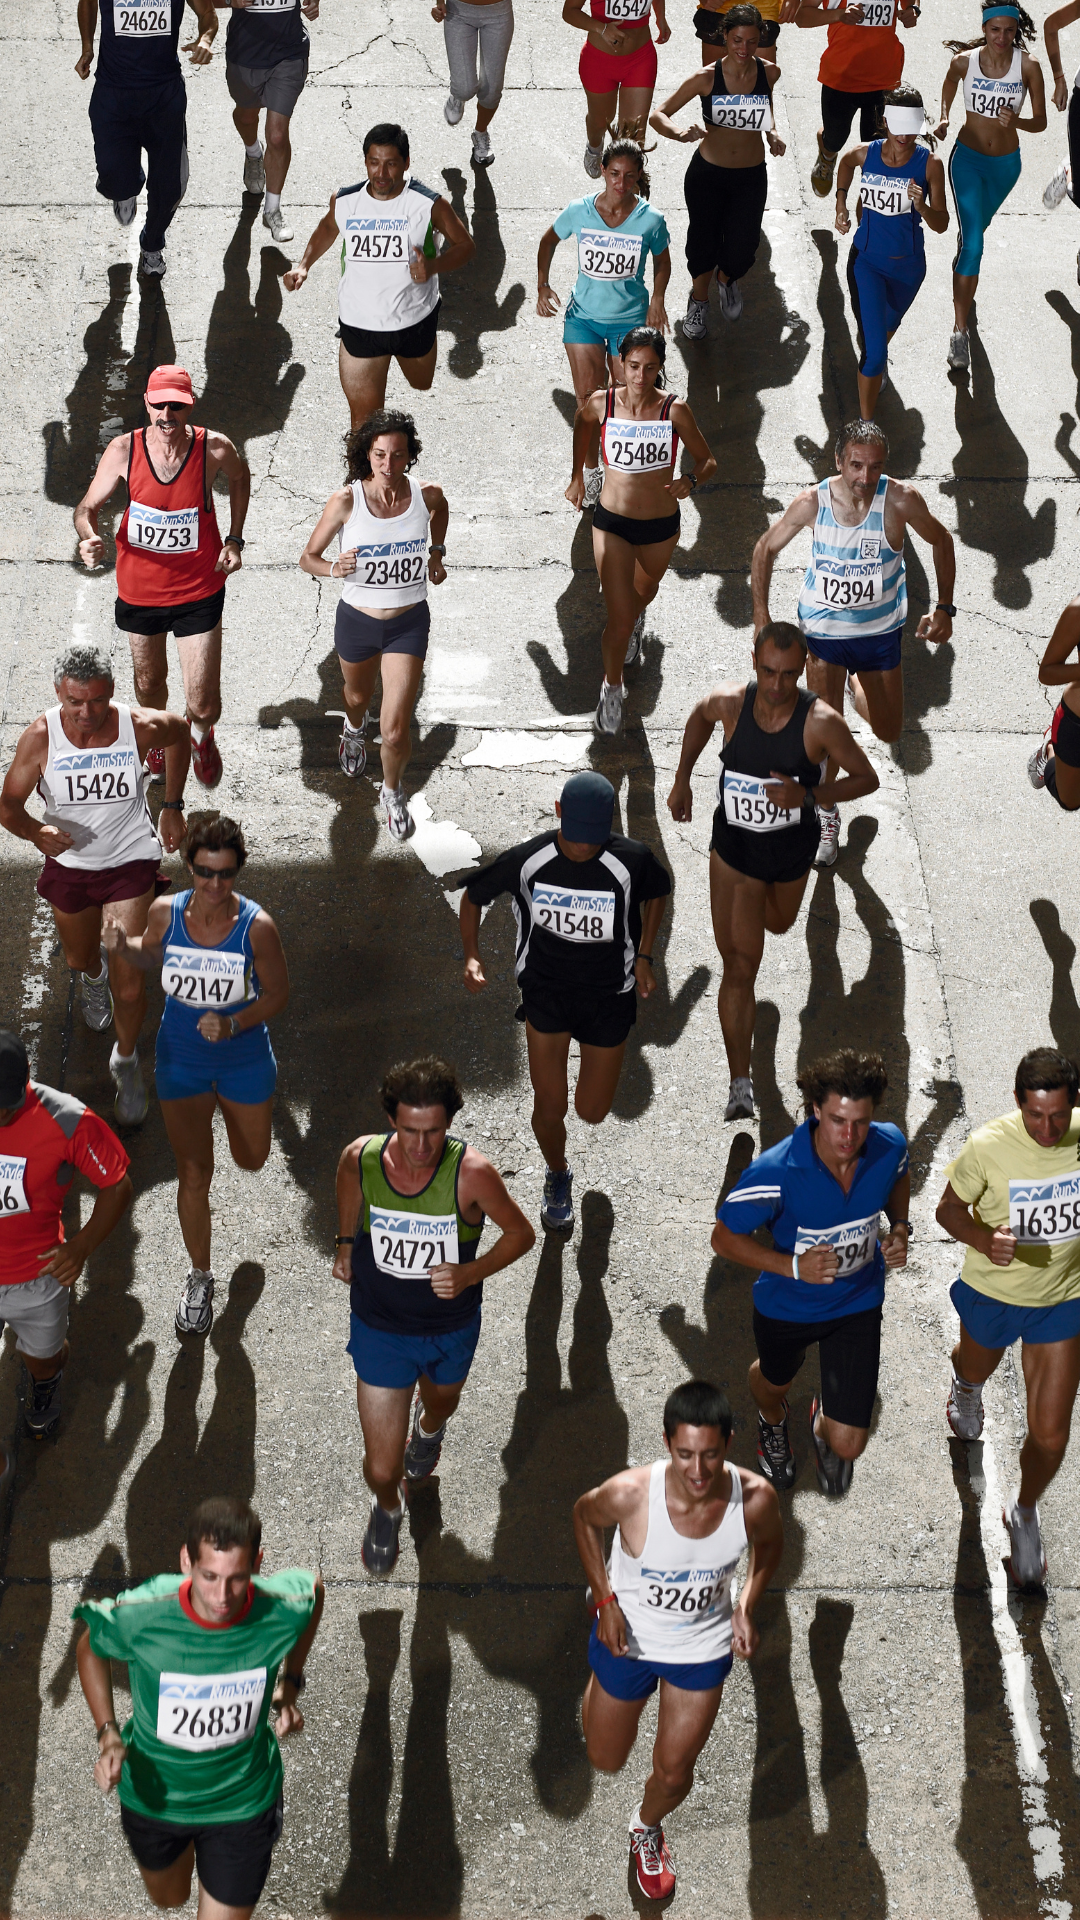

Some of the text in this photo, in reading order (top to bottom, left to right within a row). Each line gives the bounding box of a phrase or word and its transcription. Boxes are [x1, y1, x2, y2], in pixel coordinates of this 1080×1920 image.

[606, 0, 648, 17] 16542
[856, 4, 892, 26] 493
[120, 10, 167, 31] 24626
[993, 80, 1023, 94] RunStyle
[739, 94, 770, 106] RunStyle
[971, 92, 1016, 117] 13485
[717, 108, 766, 129] 23547
[880, 176, 911, 190] RunStyl
[860, 187, 902, 213] 21541
[374, 219, 408, 232] RunStyle
[351, 234, 403, 258] 24573
[607, 236, 642, 252] RunStyle
[584, 249, 636, 275] 32584
[635, 425, 672, 439] RunStyle
[611, 440, 669, 466] 25486
[161, 512, 199, 526] RunStyle
[136, 523, 191, 548] 19753
[389, 540, 426, 556] RunStyle
[365, 556, 423, 585] 23482
[843, 563, 882, 578] RunStyle
[822, 577, 875, 605] 12394
[91, 751, 135, 769] RunStyle
[65, 772, 130, 802] 15426
[732, 796, 792, 824] 13594
[570, 895, 615, 914] RunStyle
[539, 908, 604, 939] 21548
[199, 956, 244, 976] RunStyle
[170, 973, 234, 1003] 22147
[0, 1185, 19, 1211] 6
[408, 1219, 458, 1236] RunStyle
[1016, 1199, 1080, 1238] 16358
[380, 1235, 446, 1269] 24721
[834, 1236, 870, 1268] 594
[209, 1677, 265, 1700] RunStyle
[172, 1700, 253, 1738] 26831
